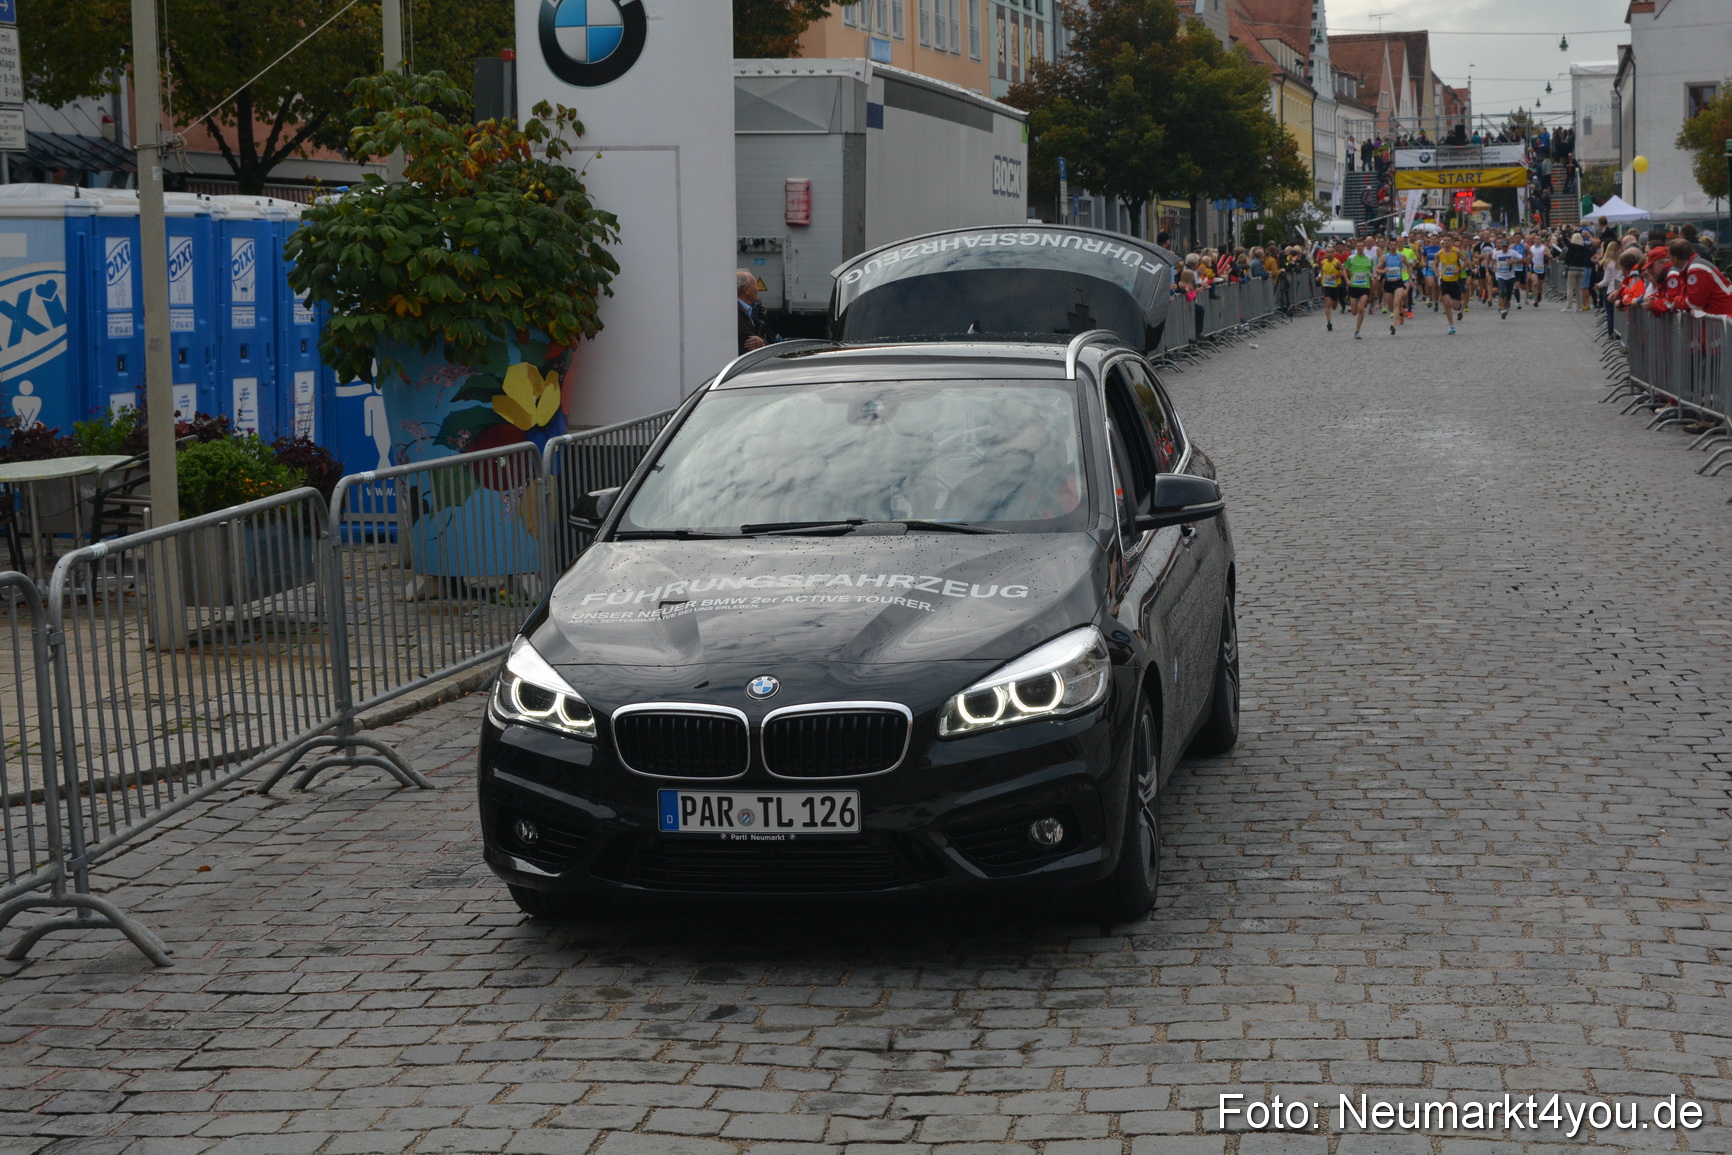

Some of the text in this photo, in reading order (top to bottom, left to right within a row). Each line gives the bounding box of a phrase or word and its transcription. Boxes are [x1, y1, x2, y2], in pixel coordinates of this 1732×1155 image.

[993, 155, 1021, 198] BOCK
[1438, 172, 1483, 184] START
[845, 232, 1163, 284] FÜHRUNGSFAHRZEUG
[580, 574, 1029, 606] FÜHRUNGSFAHRZEUG
[572, 595, 935, 620] UNSER NEUER BMW 2er ACTIVE TOURER.
[657, 613, 676, 621] LIVE
[678, 608, 692, 617] BEI
[666, 815, 674, 824] D
[680, 795, 855, 827] PAR TL 126
